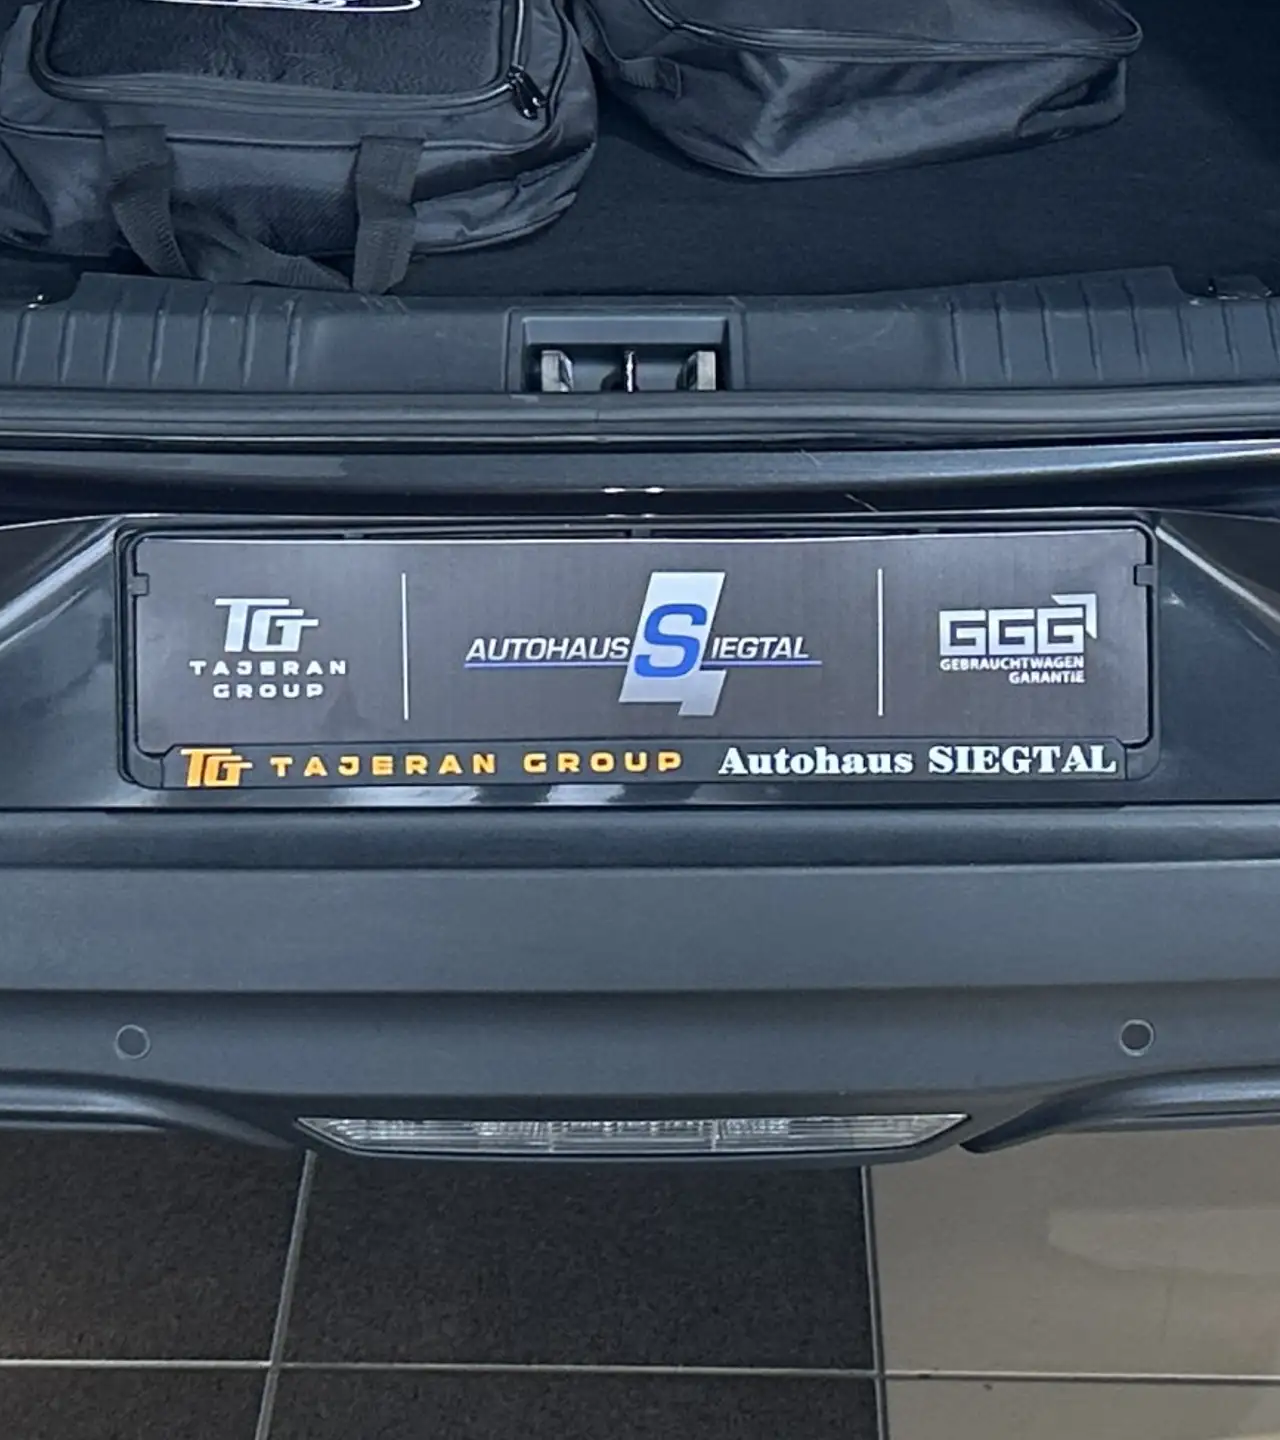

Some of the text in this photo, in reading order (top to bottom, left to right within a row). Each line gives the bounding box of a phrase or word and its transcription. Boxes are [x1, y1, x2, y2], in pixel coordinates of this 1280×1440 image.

[214, 598, 320, 653] TG
[939, 607, 1085, 656] GGG
[465, 635, 631, 661] AUTOHAUS
[189, 660, 348, 677] TAJERAN
[939, 655, 1085, 671] GEBRAUCHTWAGEN
[1008, 670, 1085, 684] GARANTIE
[213, 683, 324, 699] GROUP
[270, 753, 497, 777] TAJERAN
[523, 751, 683, 774] GROUP
[718, 746, 913, 775] Autohaus
[928, 745, 1118, 775] SIEGTAL
